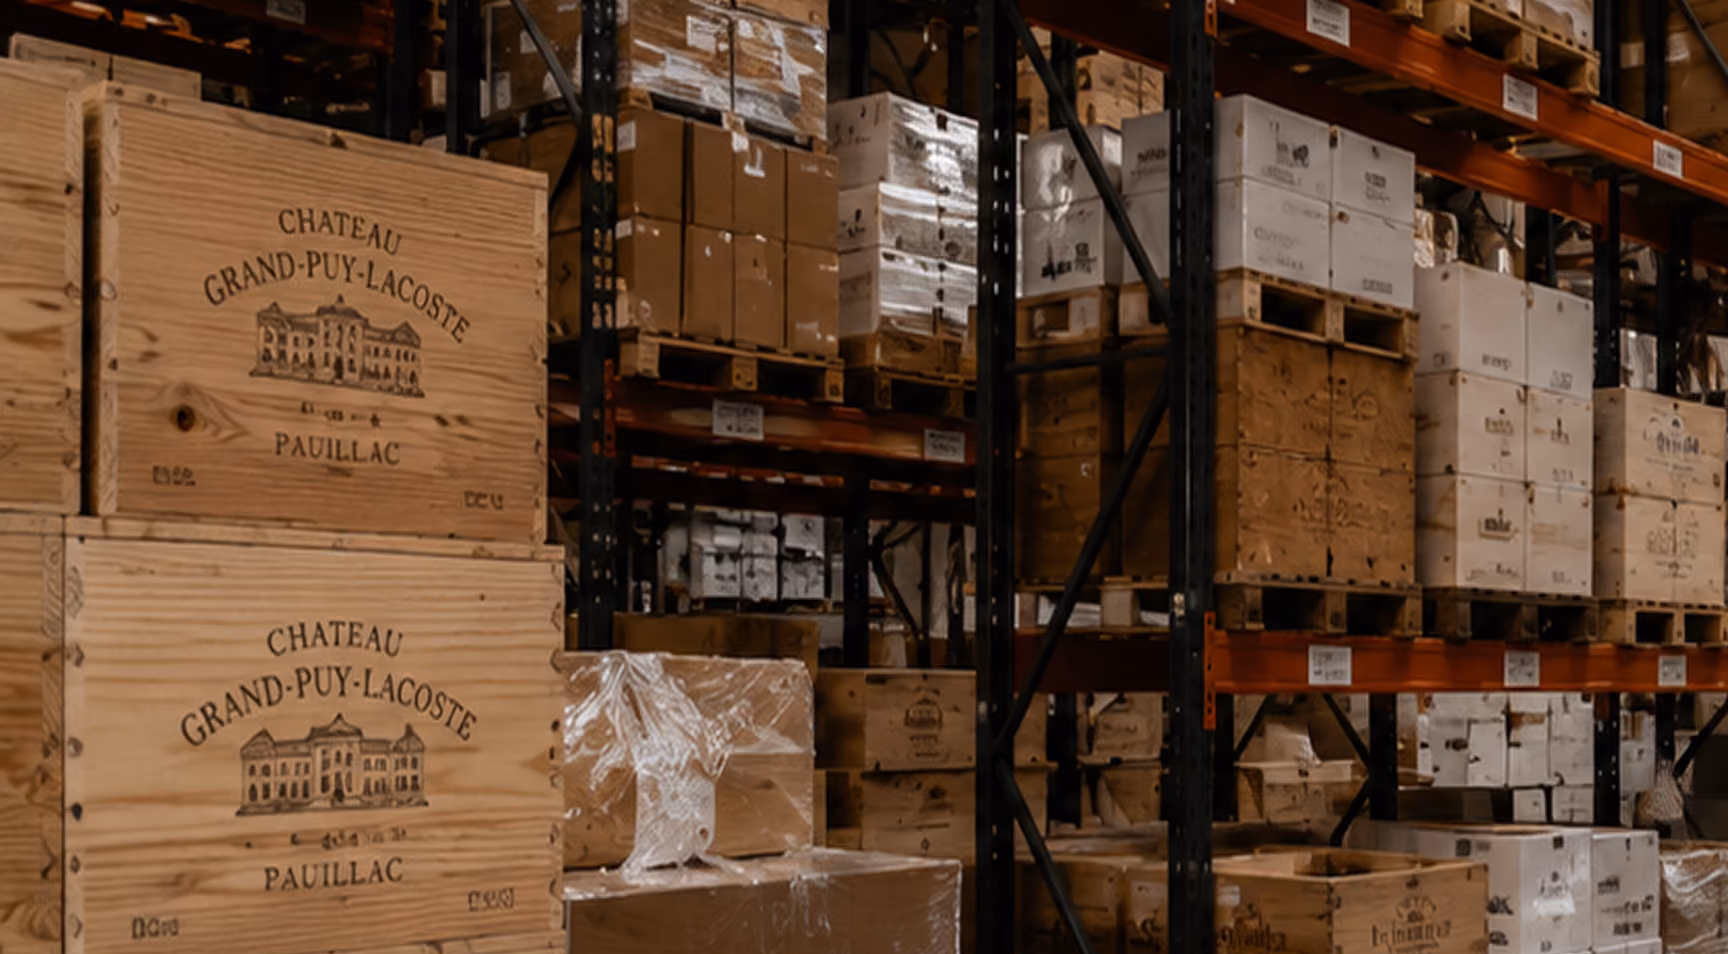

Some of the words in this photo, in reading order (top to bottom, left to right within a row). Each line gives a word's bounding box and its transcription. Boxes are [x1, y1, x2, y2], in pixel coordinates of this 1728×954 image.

[278, 208, 402, 256] CHATEAU
[203, 250, 471, 343] GRAND-PUY-LACOSTE
[274, 432, 400, 466] PAUILLAC
[267, 620, 403, 657] CHATEAU
[180, 666, 477, 747] GRAND-PUY-LACOSTE
[264, 857, 403, 891] PAUILLAC
